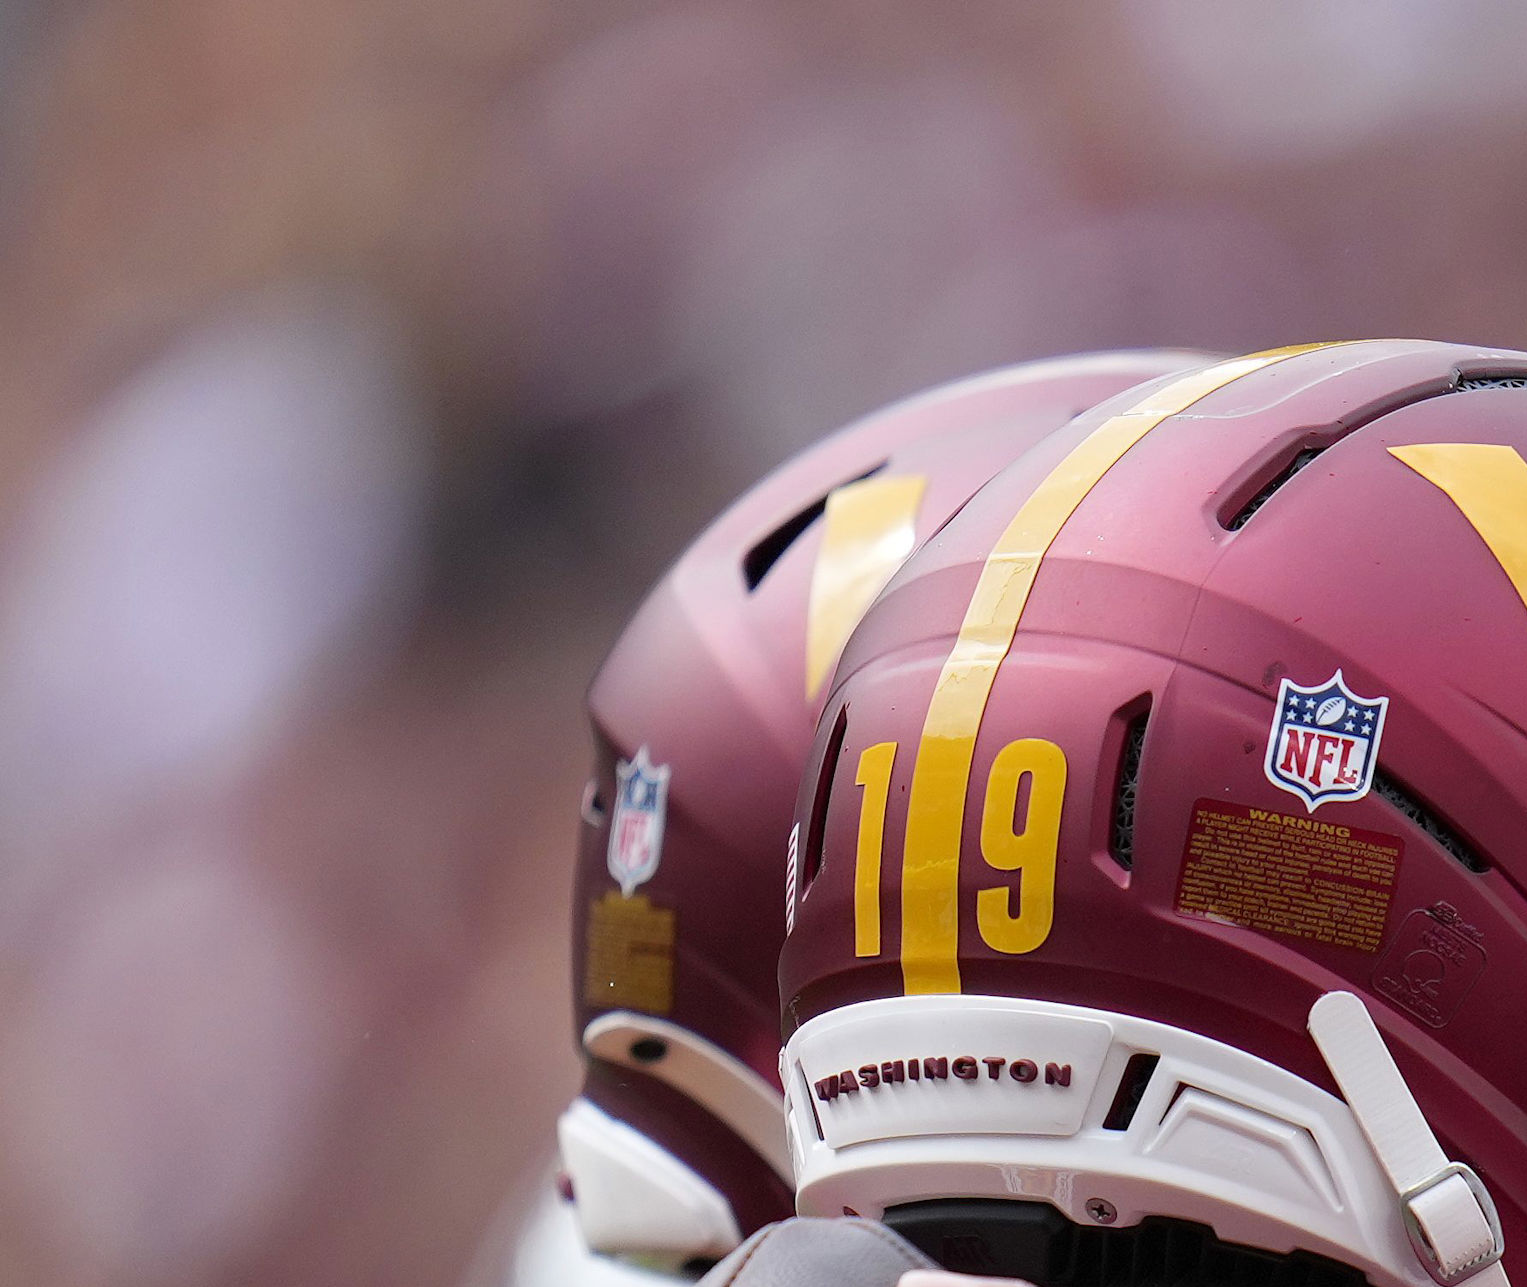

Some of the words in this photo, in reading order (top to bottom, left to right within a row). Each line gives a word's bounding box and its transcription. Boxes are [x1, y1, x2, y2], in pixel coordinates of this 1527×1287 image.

[1280, 729, 1357, 788] NFL
[1249, 809, 1350, 837] WARNING
[814, 1055, 1073, 1101] WASHINGTON
